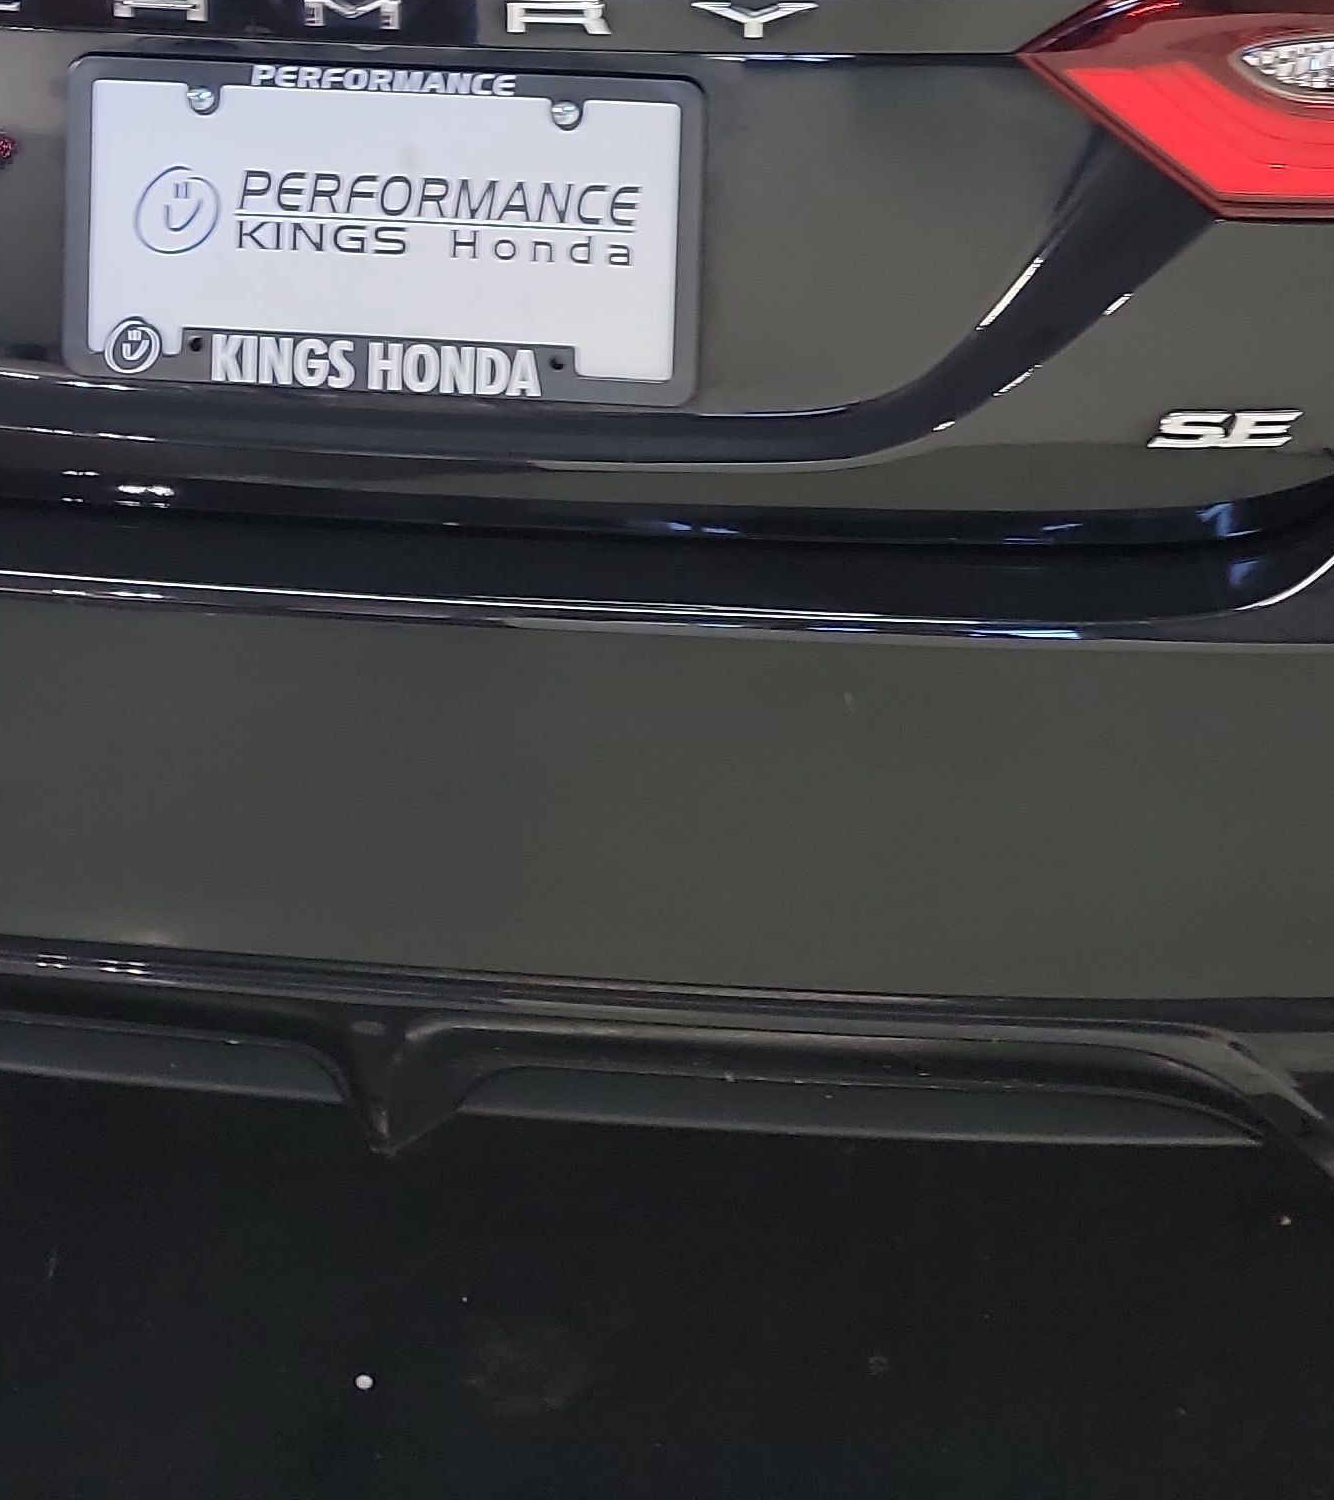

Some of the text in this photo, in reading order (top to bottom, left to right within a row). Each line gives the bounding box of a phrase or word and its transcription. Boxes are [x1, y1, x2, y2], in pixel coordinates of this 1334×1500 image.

[250, 64, 517, 97] PERFORMANCE
[240, 169, 643, 227] PERFORMANCE
[234, 221, 635, 267] KINGS Honda
[210, 333, 542, 397] KINGS HONDA
[1146, 408, 1305, 449] SE
